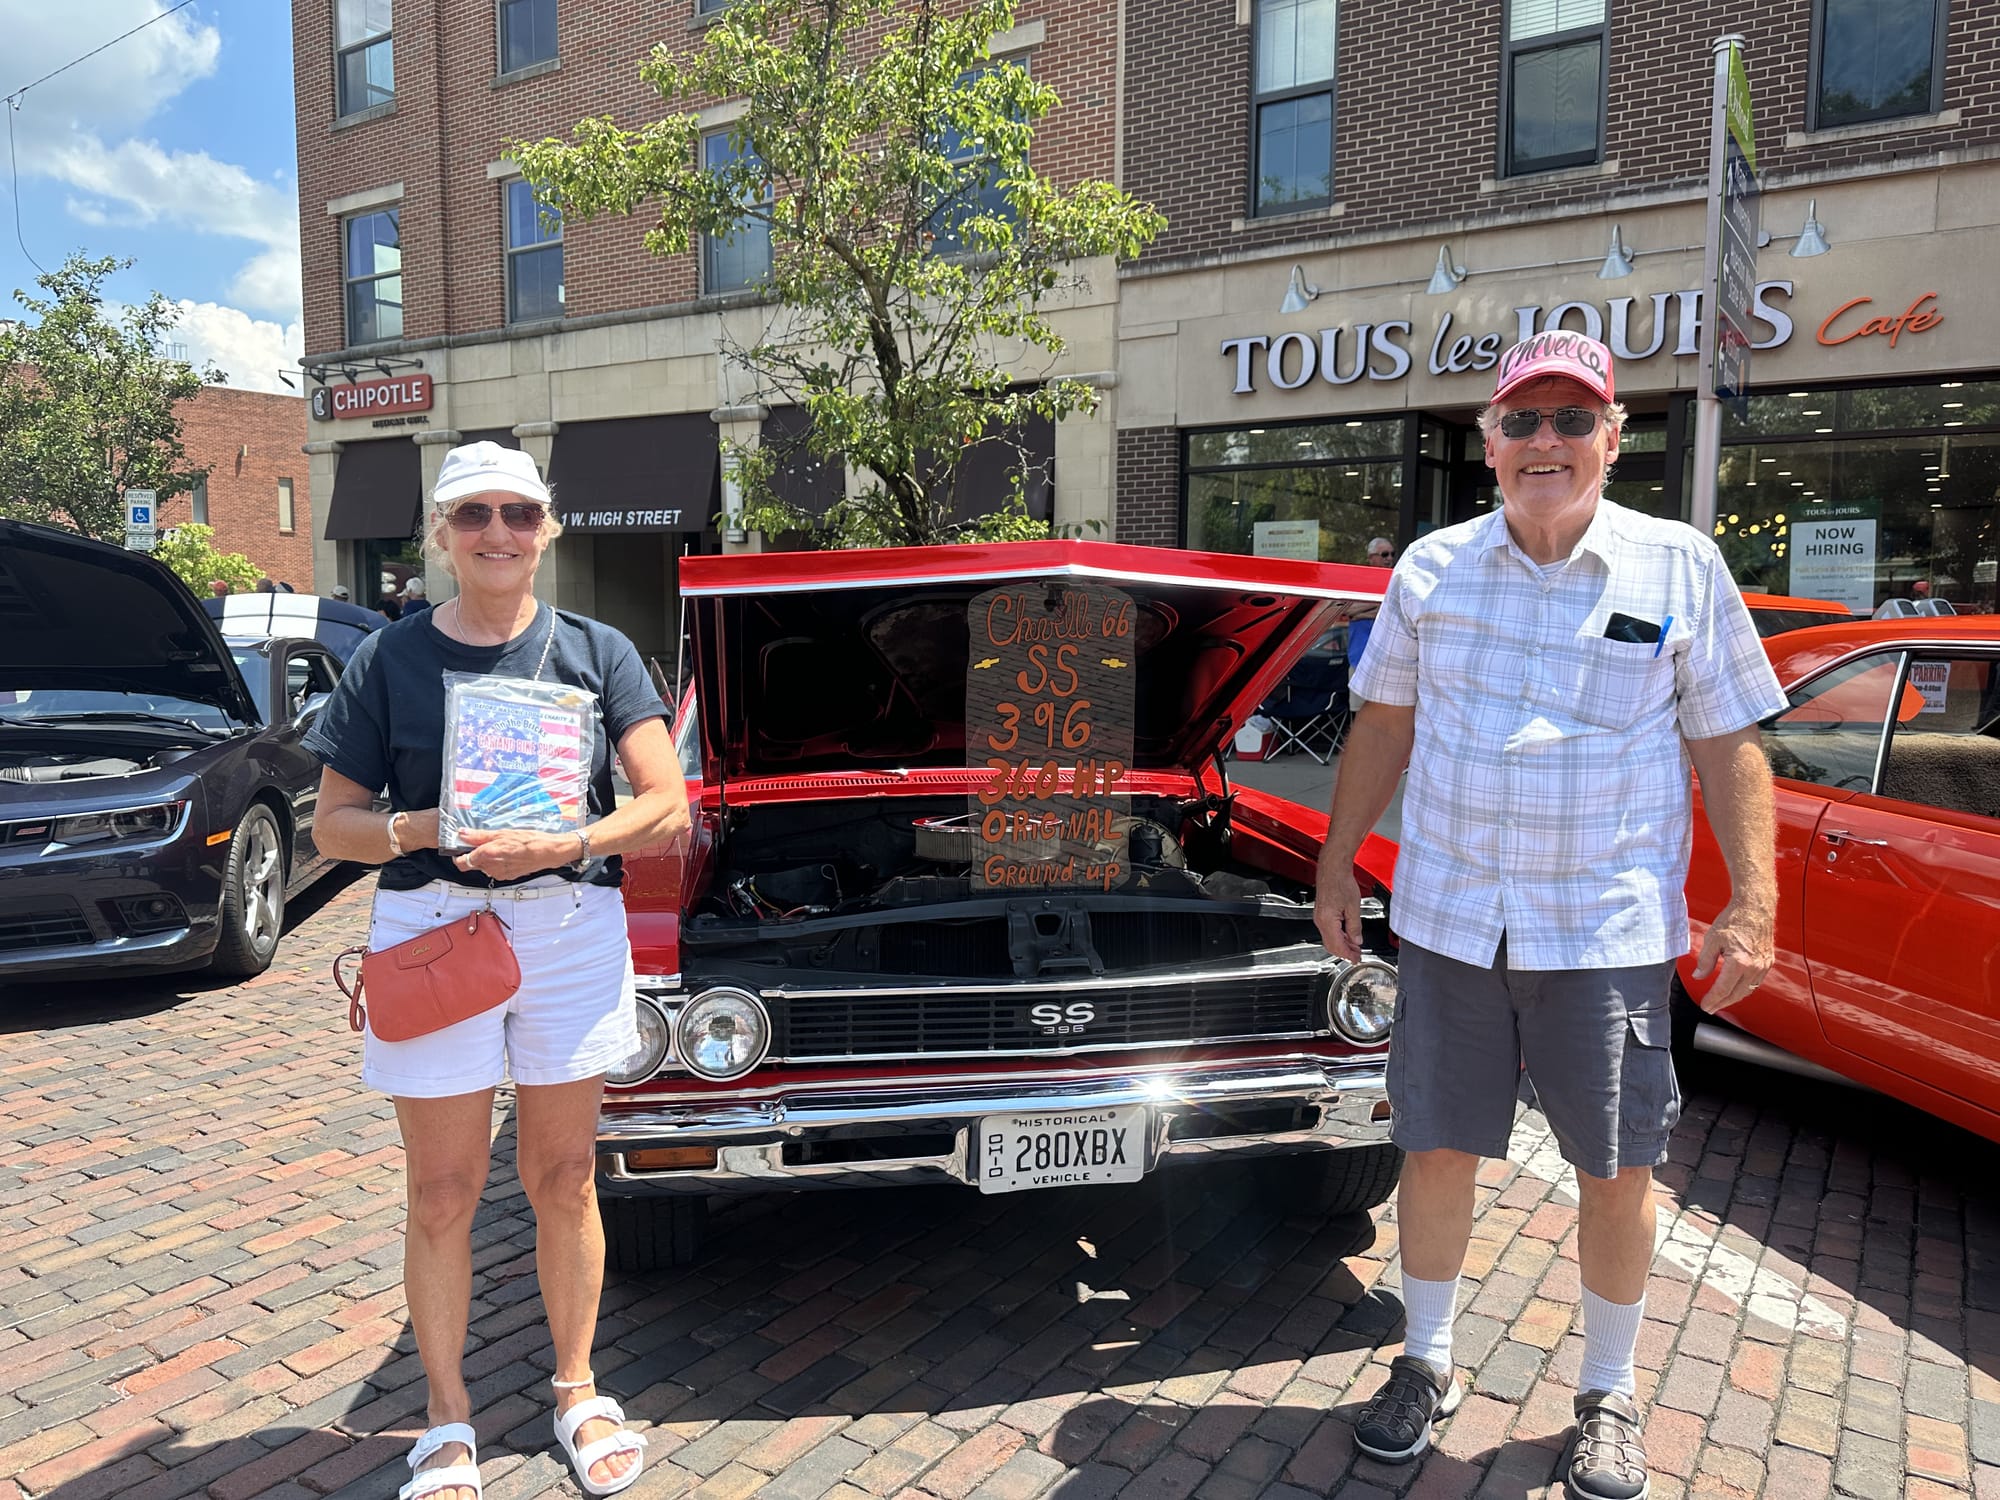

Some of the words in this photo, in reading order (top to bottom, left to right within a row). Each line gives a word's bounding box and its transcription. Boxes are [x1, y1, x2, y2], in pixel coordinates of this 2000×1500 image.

[1220, 320, 1412, 394] TOUS
[1427, 311, 1502, 376] les
[1816, 292, 1944, 348] Café
[1502, 333, 1607, 382] Chevelle
[334, 381, 423, 410] CHIPOTLE
[571, 512, 585, 526] W.
[588, 511, 622, 526] HIGH
[626, 510, 682, 525] STREET
[1835, 507, 1860, 515] JOURS
[1816, 527, 1855, 540] NOW
[1806, 543, 1864, 556] HIRING
[1016, 644, 1080, 697] SS
[506, 718, 520, 727] the
[523, 719, 547, 738] Bricks
[544, 714, 568, 722] CHARITY
[987, 700, 1092, 751] 396
[978, 758, 1059, 805] 360
[1072, 758, 1125, 799] HP
[1031, 1002, 1095, 1025] SS
[1043, 1024, 1085, 1034] 396
[1018, 1115, 1107, 1127] HISTORICAL
[988, 1133, 1004, 1178] OHIO
[1016, 1127, 1127, 1173] 280XBX
[1032, 1172, 1090, 1185] VEHICLE
